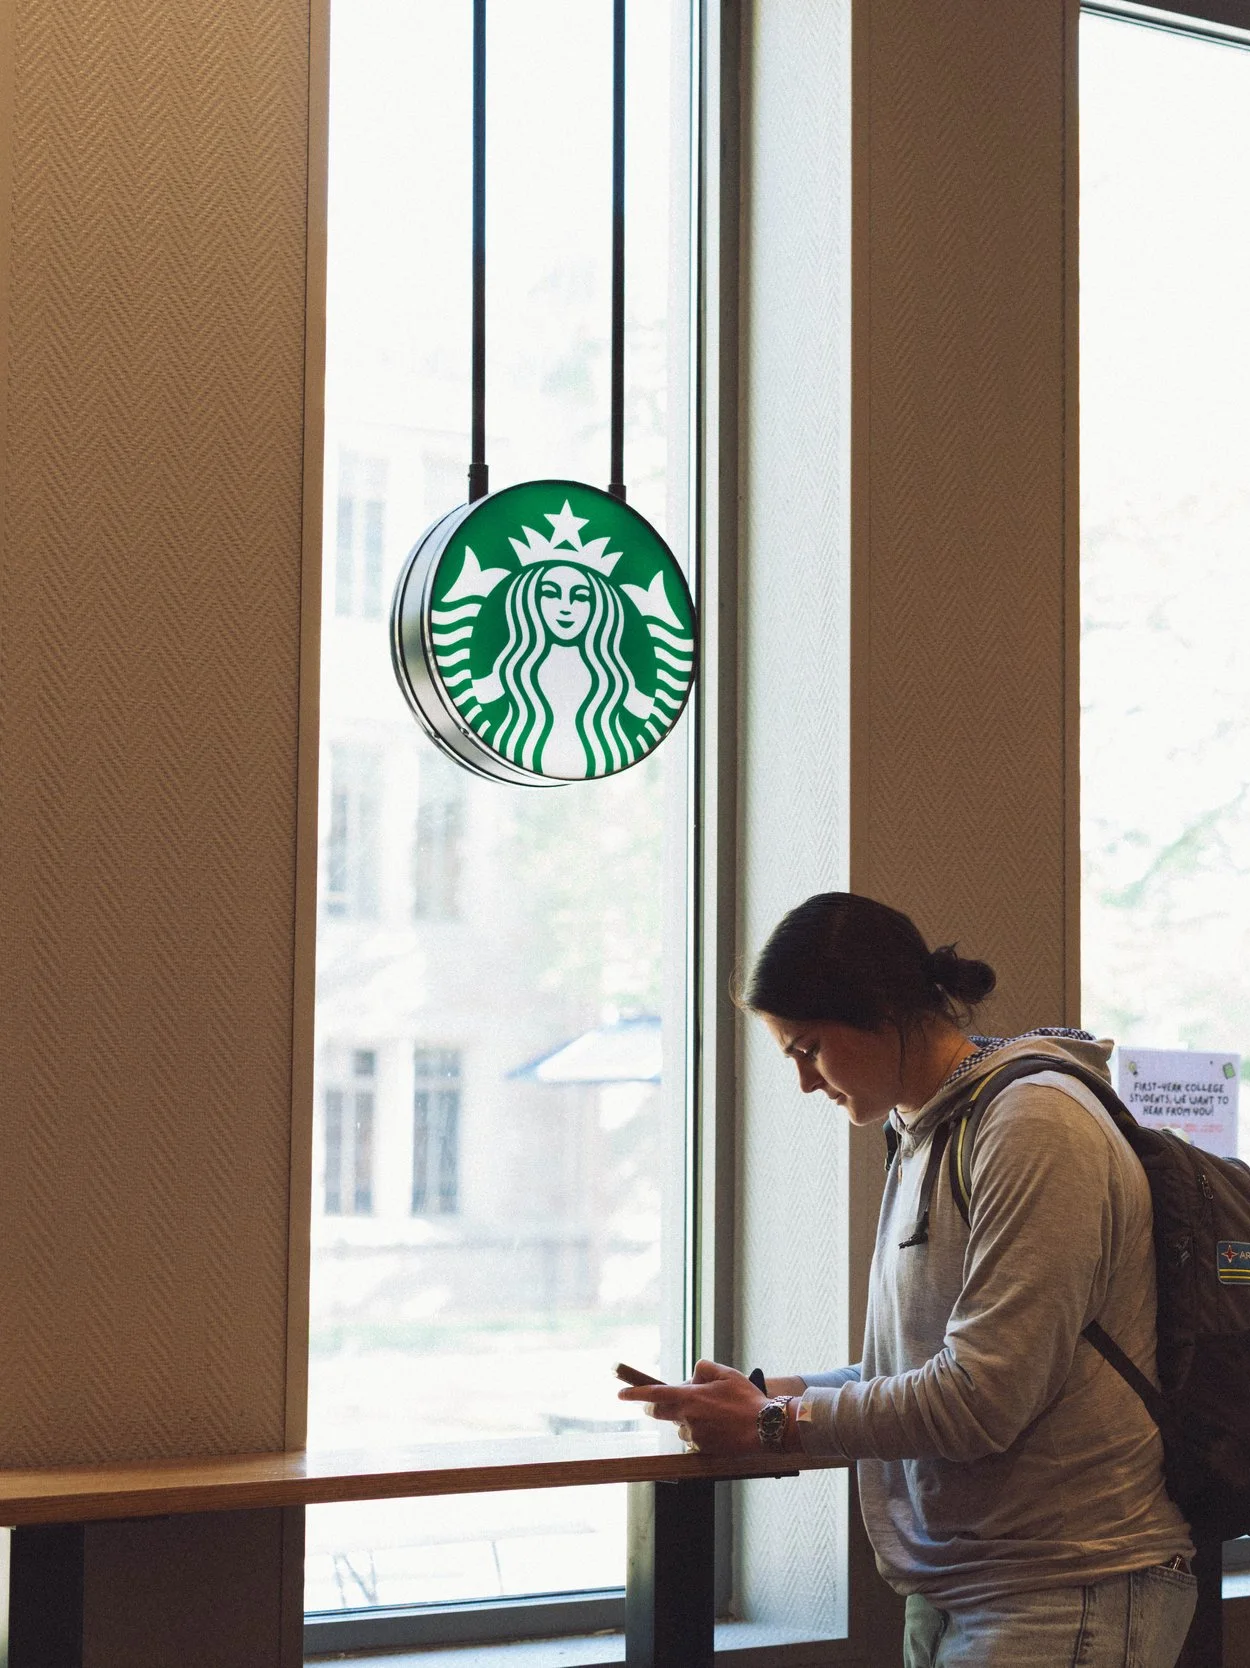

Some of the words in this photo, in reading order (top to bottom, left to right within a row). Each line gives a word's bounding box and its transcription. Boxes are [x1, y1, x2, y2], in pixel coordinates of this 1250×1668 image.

[1134, 1082, 1181, 1093] FIRST-YEAR
[1185, 1083, 1224, 1093] COLLEGE
[1174, 1094, 1186, 1104] WE
[1189, 1095, 1214, 1105] WANT
[1217, 1095, 1229, 1105] TO
[1143, 1105, 1162, 1115] HEAR
[1166, 1106, 1190, 1116] FROM
[1193, 1105, 1214, 1116] YOU!
